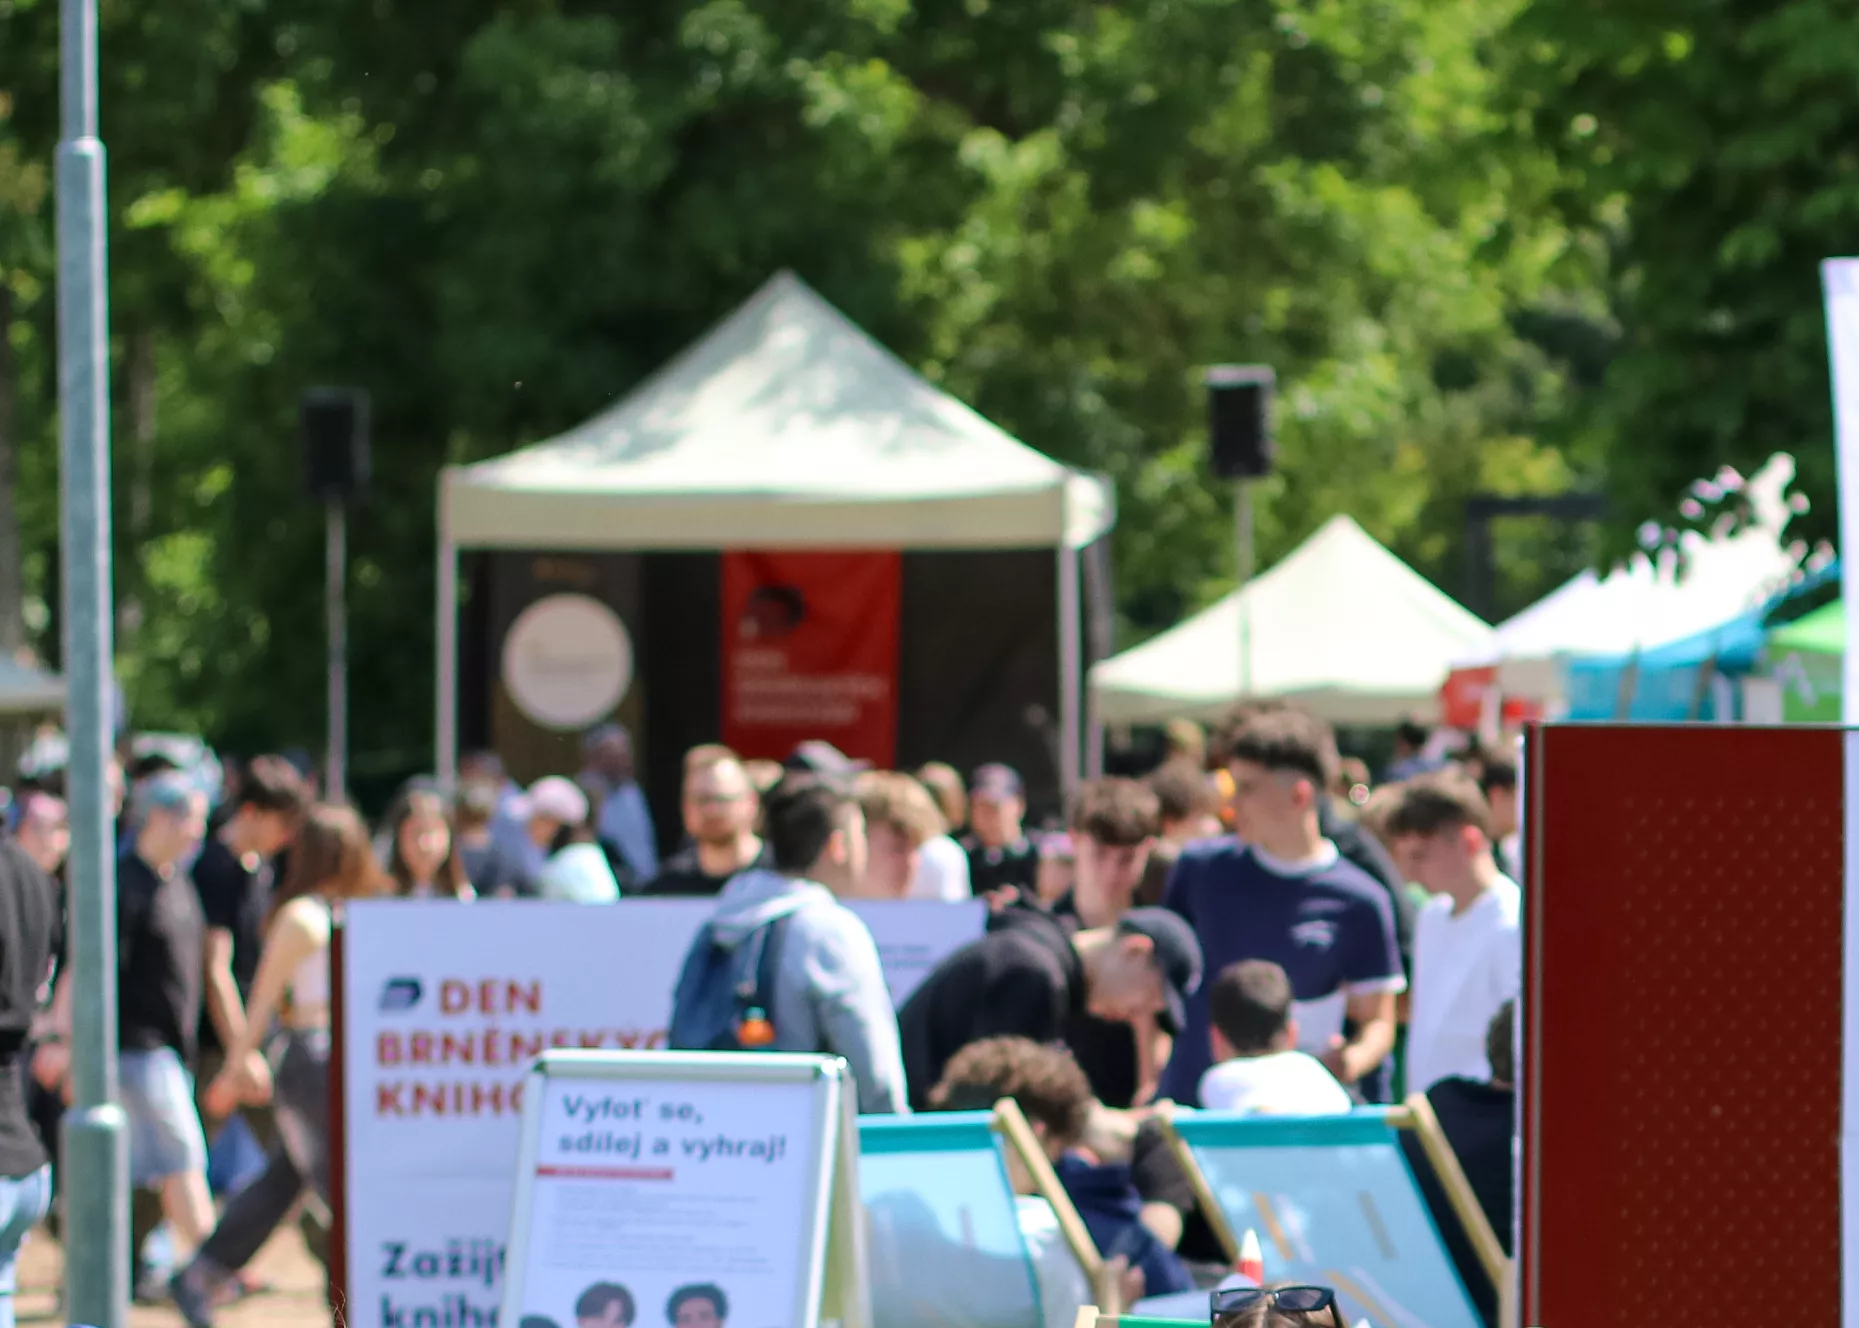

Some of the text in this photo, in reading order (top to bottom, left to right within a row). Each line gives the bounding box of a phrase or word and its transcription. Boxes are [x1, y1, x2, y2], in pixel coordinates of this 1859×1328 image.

[440, 979, 542, 1015] DEN
[376, 1022, 669, 1067] BRNĚN
[376, 1082, 523, 1115] KNIH
[658, 1101, 703, 1124] se,
[652, 1137, 670, 1155] a
[680, 1134, 787, 1163] vyhraj!
[381, 1239, 506, 1286] Zažij
